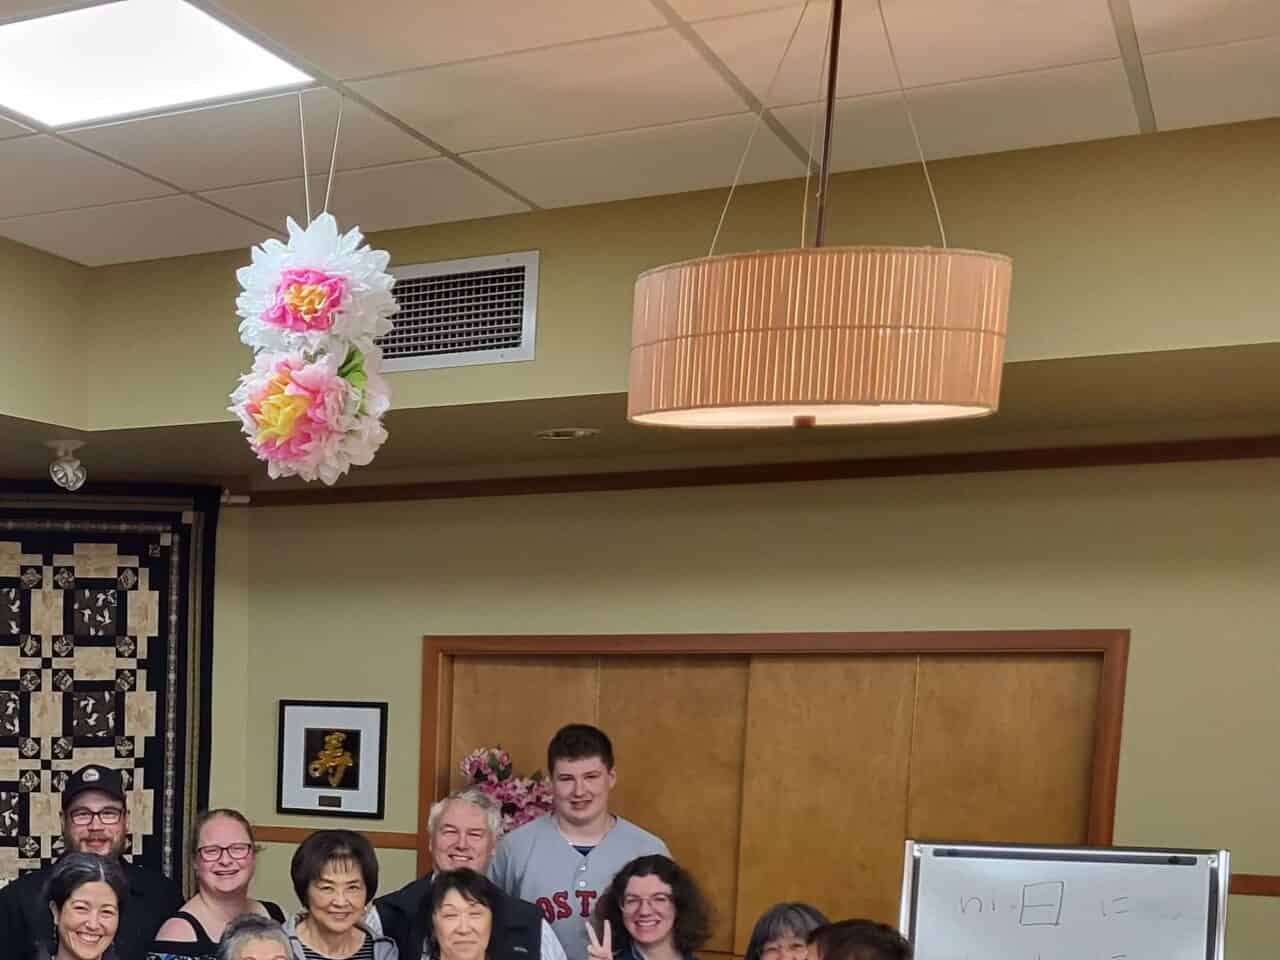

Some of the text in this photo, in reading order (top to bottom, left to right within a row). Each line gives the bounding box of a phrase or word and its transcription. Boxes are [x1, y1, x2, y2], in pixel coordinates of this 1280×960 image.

[536, 890, 597, 924] OST
[1019, 880, 1064, 926] 日
[1101, 896, 1128, 917] に
